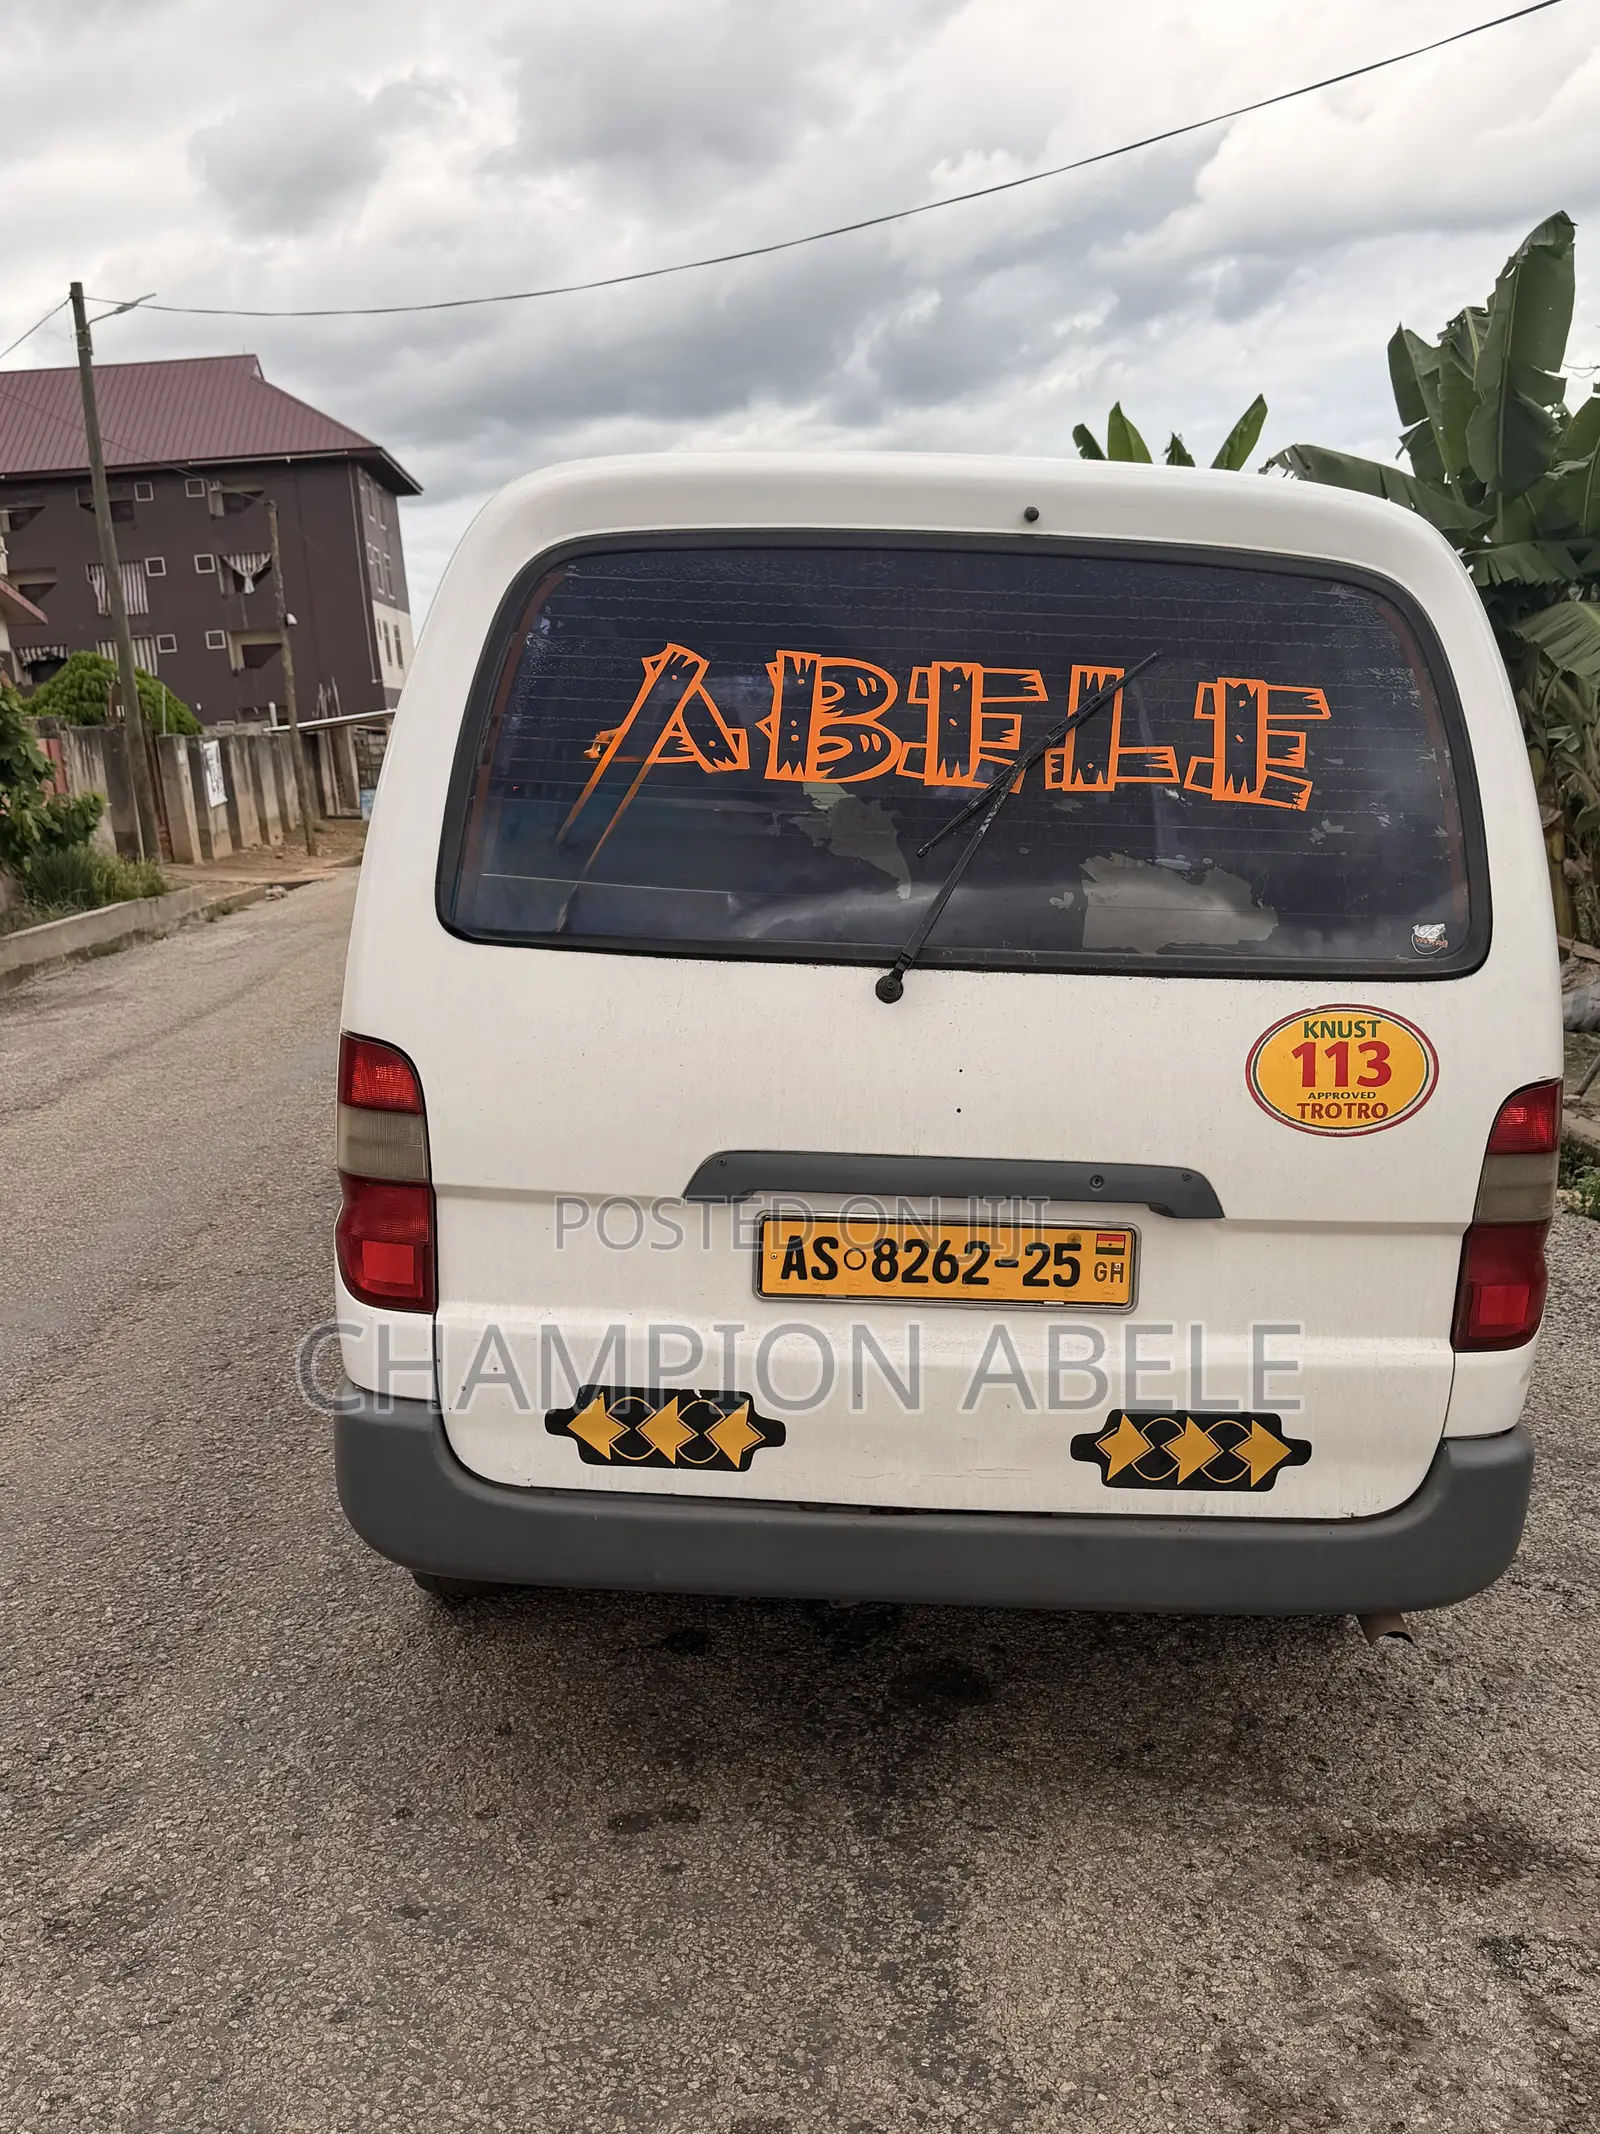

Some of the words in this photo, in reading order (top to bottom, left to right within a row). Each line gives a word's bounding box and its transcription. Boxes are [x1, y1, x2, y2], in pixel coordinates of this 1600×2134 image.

[584, 643, 1331, 811] ABELE
[1303, 1019, 1382, 1040] KNUST
[1291, 1040, 1392, 1088] 113
[1307, 1091, 1377, 1101] APPROVED
[1296, 1102, 1389, 1120] TROTRO
[779, 1234, 839, 1281] AS
[870, 1238, 1083, 1289] 8262-25
[1092, 1260, 1125, 1284] GH
